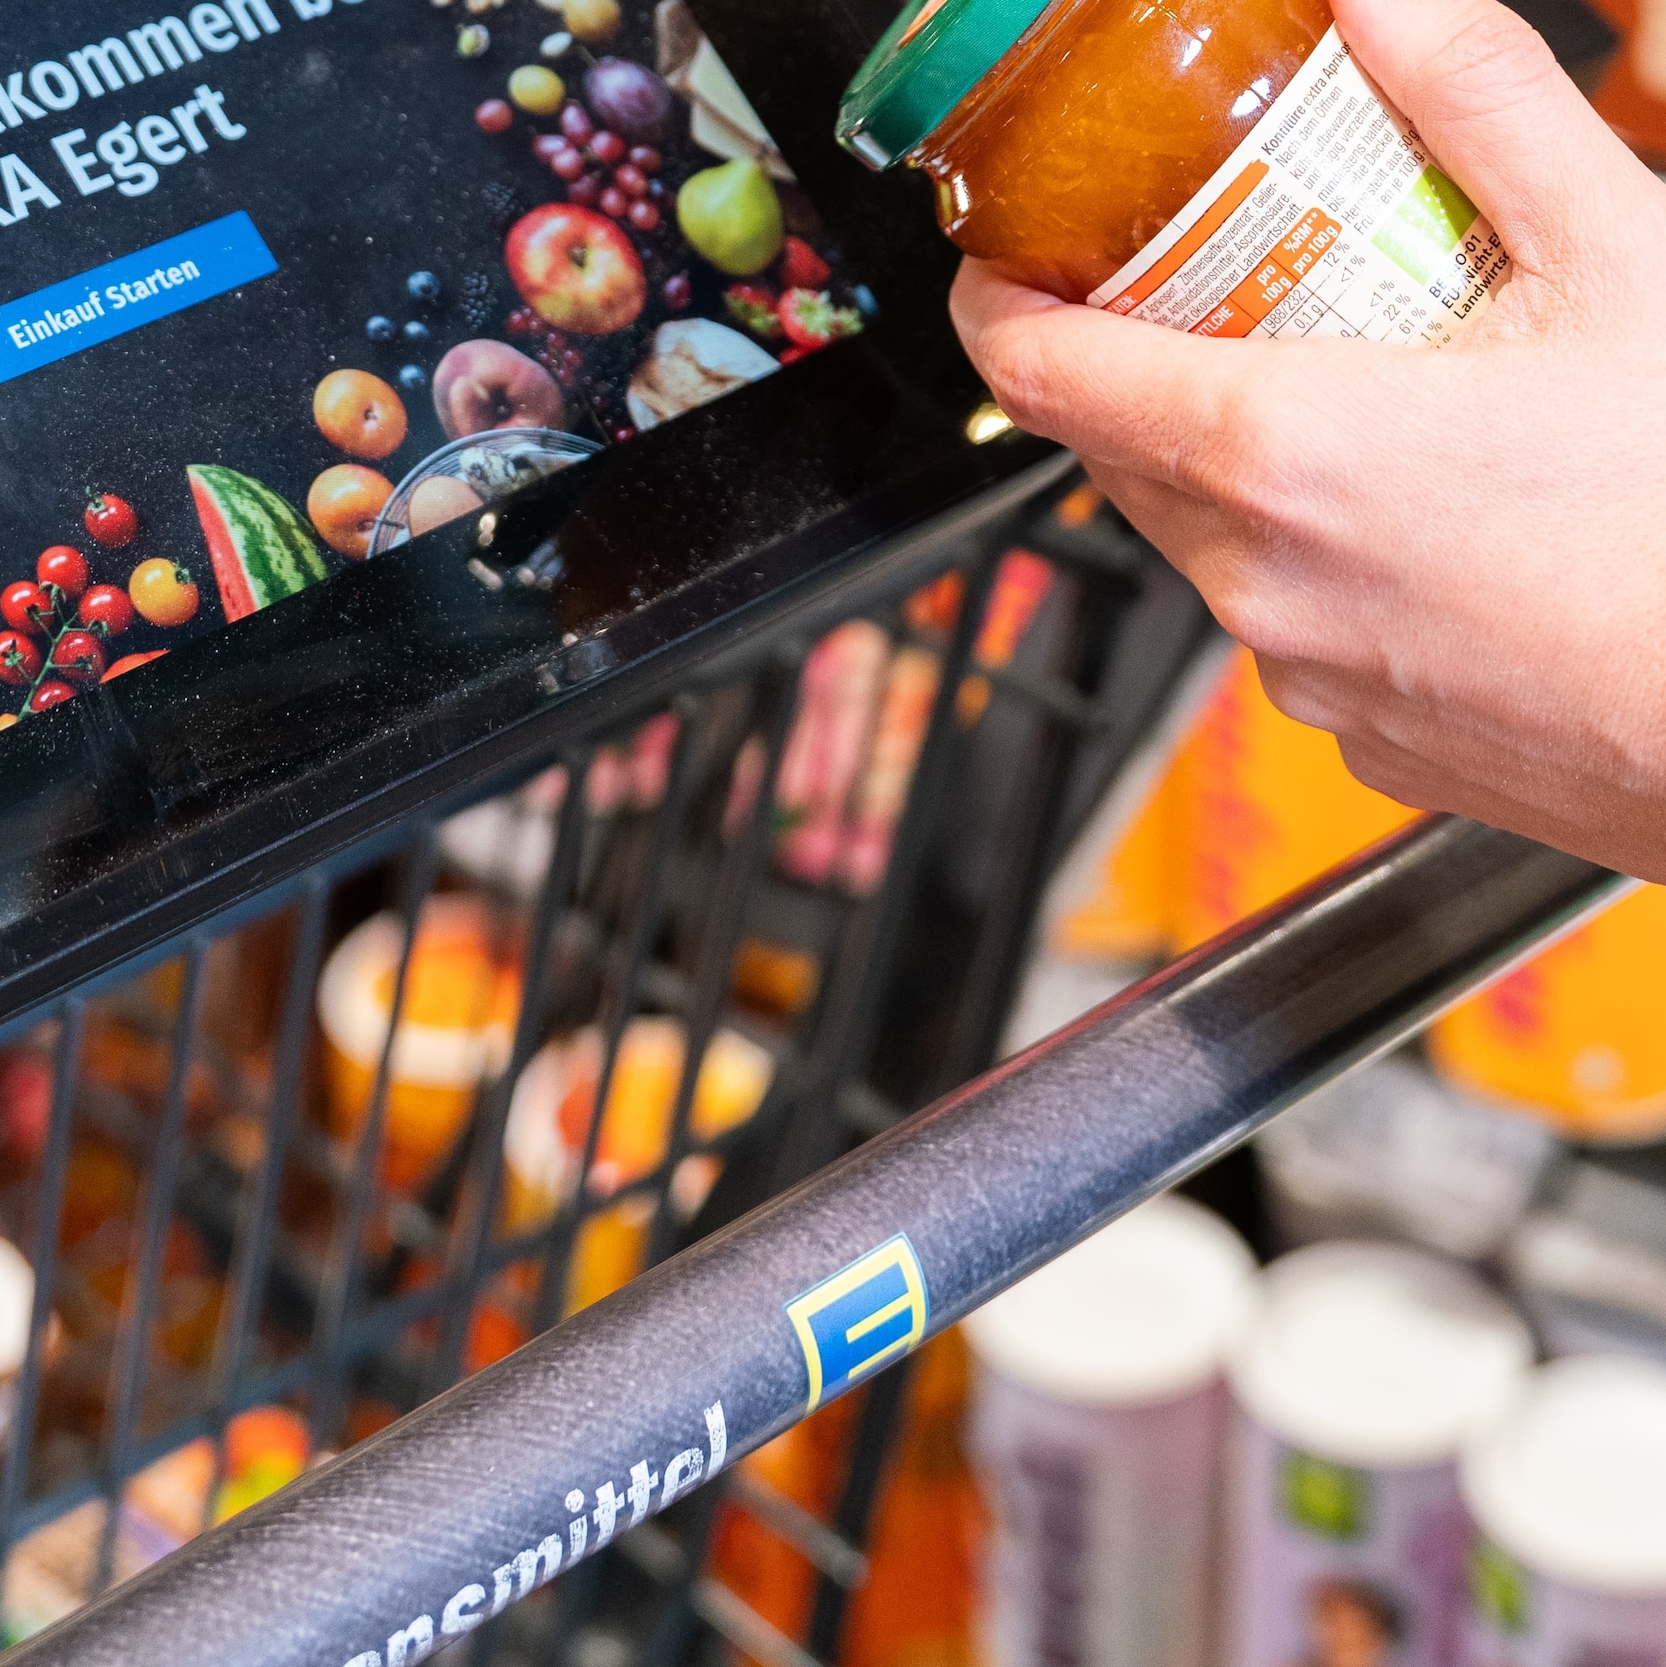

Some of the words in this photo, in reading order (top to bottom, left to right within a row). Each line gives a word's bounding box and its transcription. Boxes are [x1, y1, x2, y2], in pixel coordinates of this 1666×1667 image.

[1261, 104, 1306, 155] Konfitüre
[1303, 78, 1327, 106] extra
[1275, 139, 1302, 168] Nach
[1297, 118, 1319, 141] dem
[1313, 85, 1344, 119] Öffnen
[1312, 96, 1360, 158] aufbewahren
[51, 83, 248, 197] Egert
[1303, 166, 1323, 190] und
[1341, 96, 1380, 143] verzehren.
[1317, 143, 1366, 202] mindestens
[1361, 109, 1391, 145] haltbar
[1363, 129, 1395, 166] Deckel
[1251, 183, 1277, 209] Gelier-
[1341, 168, 1389, 224] Hergestellt
[1386, 150, 1404, 171] aus
[1390, 177, 1403, 192] je
[1167, 250, 1239, 316] Antioxidationsmittel:
[1234, 194, 1292, 253] Ascorbinsäure.
[1188, 269, 1241, 319] ökologischer
[1236, 203, 1304, 272] Landwirtschaft.
[1292, 252, 1314, 274] pro
[1322, 251, 1340, 268] 12
[1334, 241, 1349, 253] %
[1342, 267, 1355, 281] <1
[1350, 255, 1365, 267] %
[1256, 264, 1277, 286] pro
[1371, 291, 1384, 306] <1
[1379, 280, 1394, 292] %
[6, 290, 106, 350] Einkauf
[105, 259, 201, 310] Starten
[1264, 288, 1305, 329] 988/232
[1293, 311, 1313, 329] 0,1
[1382, 303, 1401, 321] 22
[1395, 294, 1410, 306] %
[1398, 318, 1415, 334] 61
[1411, 307, 1426, 319] %
[1420, 332, 1431, 342] 1
[1427, 320, 1442, 332] %
